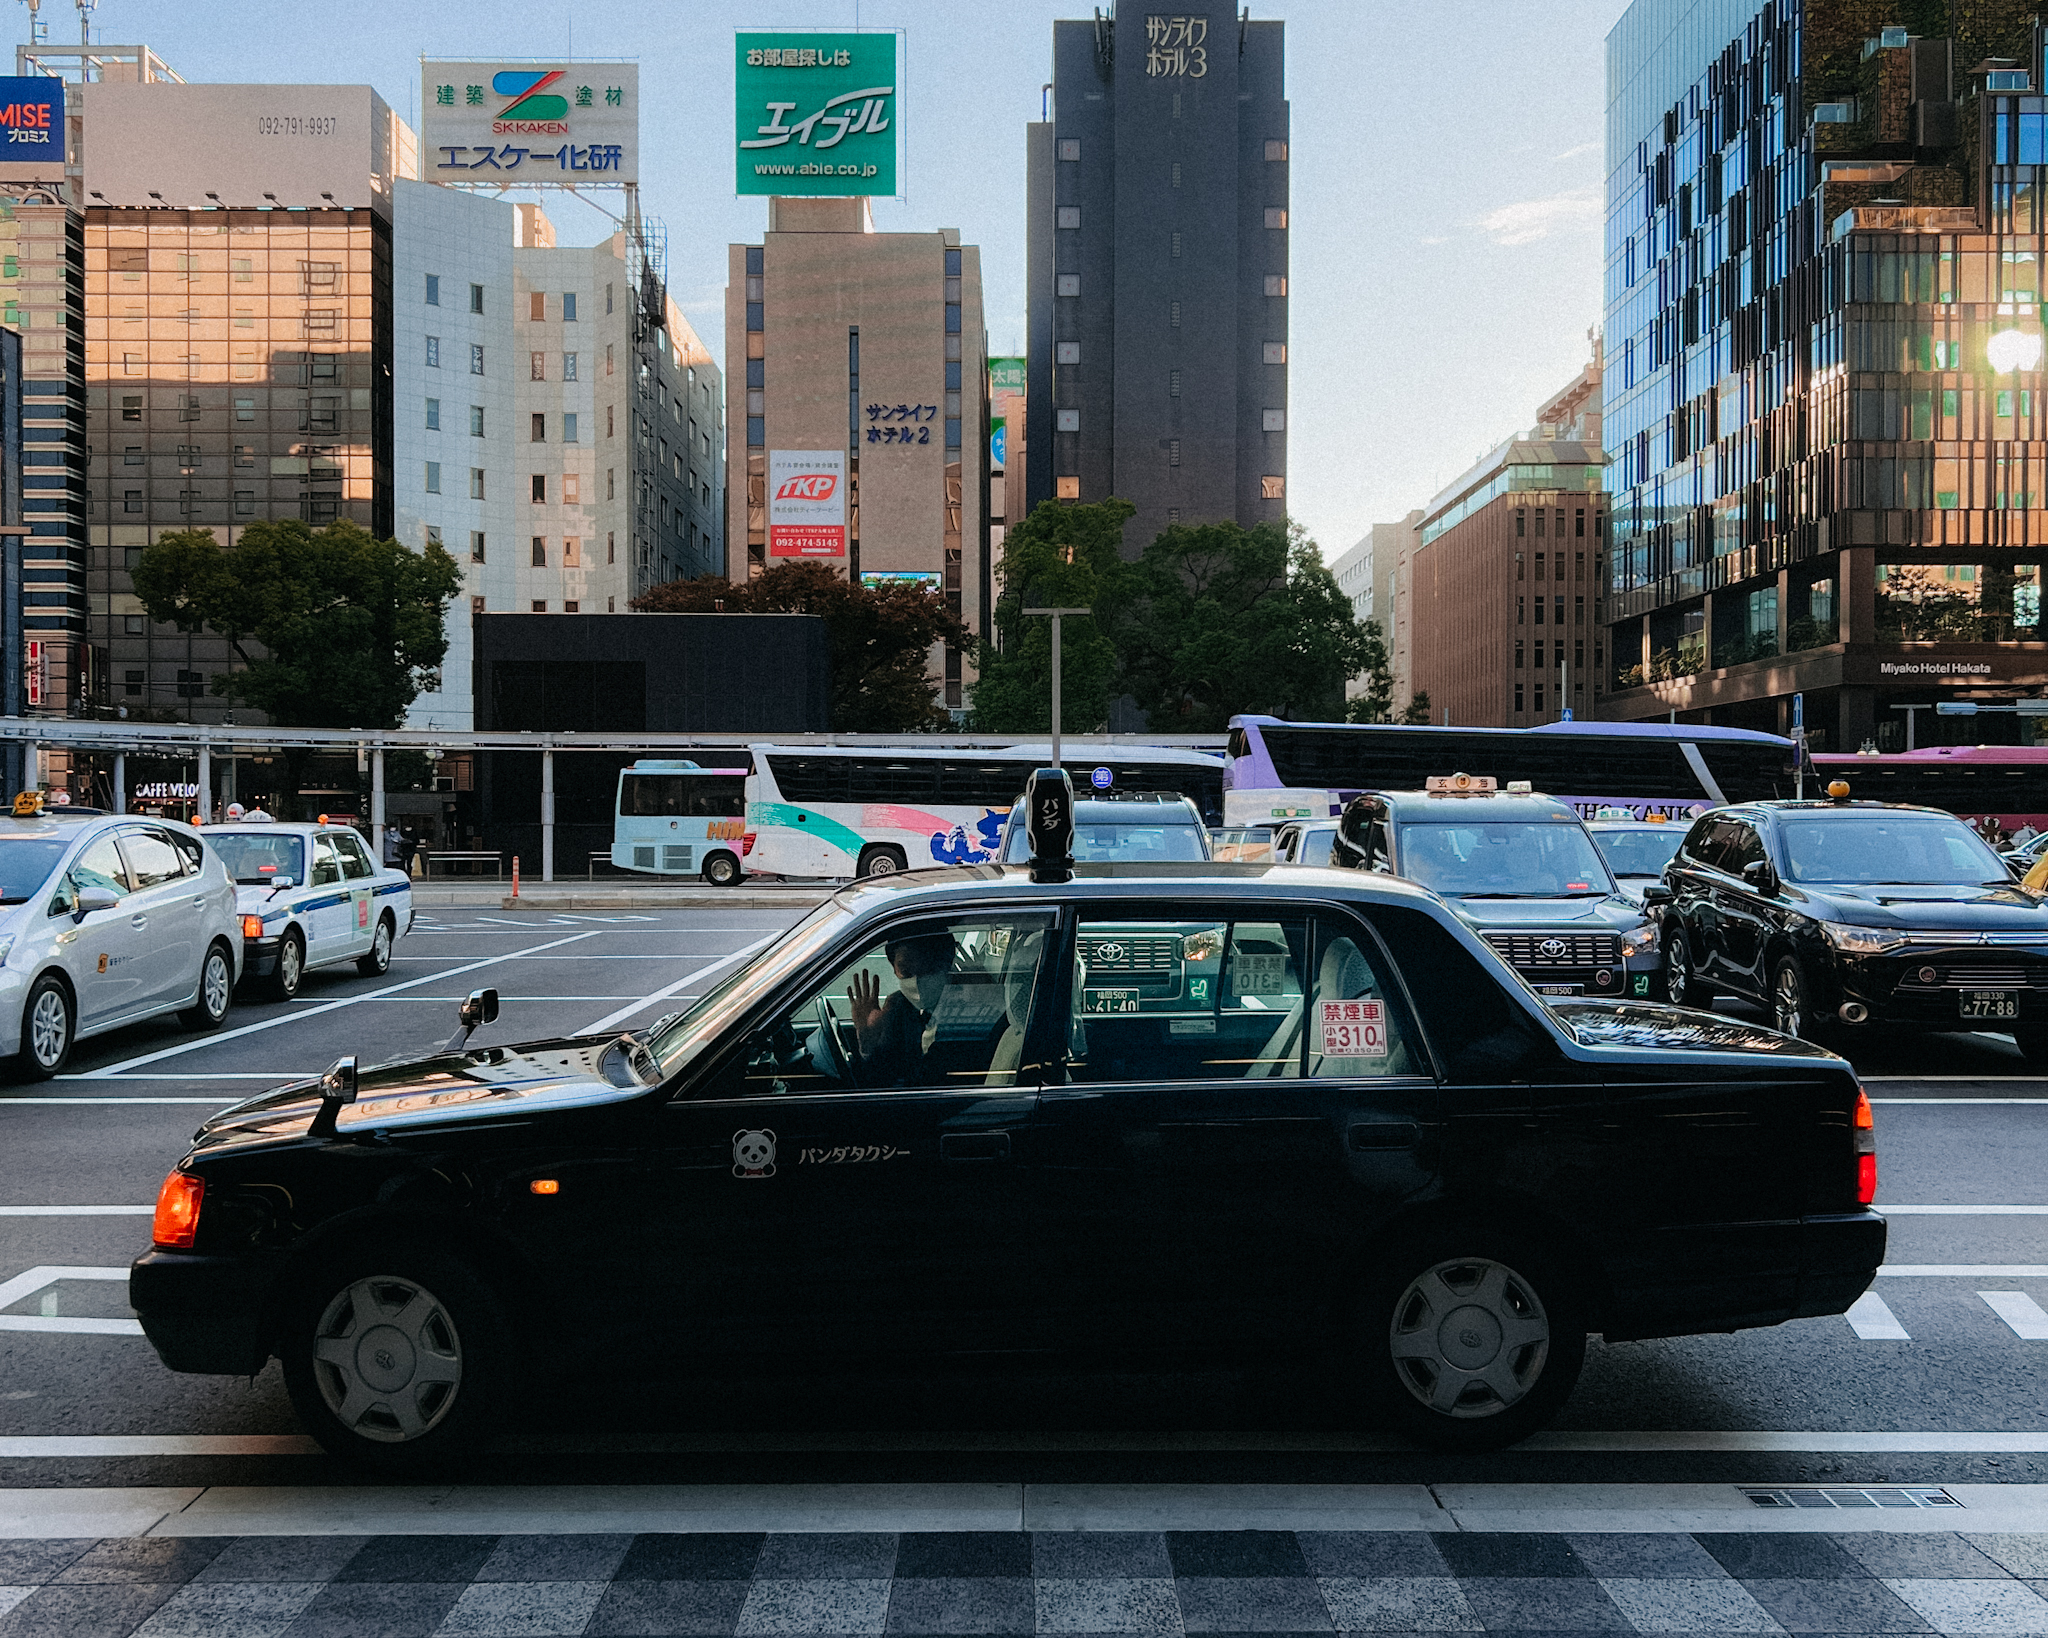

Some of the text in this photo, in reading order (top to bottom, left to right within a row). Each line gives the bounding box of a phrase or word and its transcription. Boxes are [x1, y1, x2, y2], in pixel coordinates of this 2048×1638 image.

[1146, 16, 1207, 47] サンライフ
[747, 49, 850, 66] お部屋探しは
[1146, 46, 1207, 78] ホテル3
[437, 85, 623, 106] 建築 塗材
[0, 103, 51, 128] MISE
[739, 86, 894, 148] エイブル
[259, 117, 337, 135] 092-791-9937
[516, 122, 569, 134] KAKEN
[8, 128, 50, 143] プロミス
[437, 144, 623, 171] エスケー化研
[754, 162, 877, 177] www.able.co.jp
[866, 404, 937, 422] サンライフ
[866, 426, 930, 444] ホテル 2
[782, 477, 833, 497] TKP
[776, 538, 838, 547] 092-474-5145
[1881, 663, 1991, 675] Miyako Hotel Hakata
[1042, 798, 1061, 831] パンダ
[1324, 1003, 1380, 1021] 禁煙車
[1972, 1000, 2014, 1016] 77-88
[798, 1145, 911, 1165] パンダタクシー
